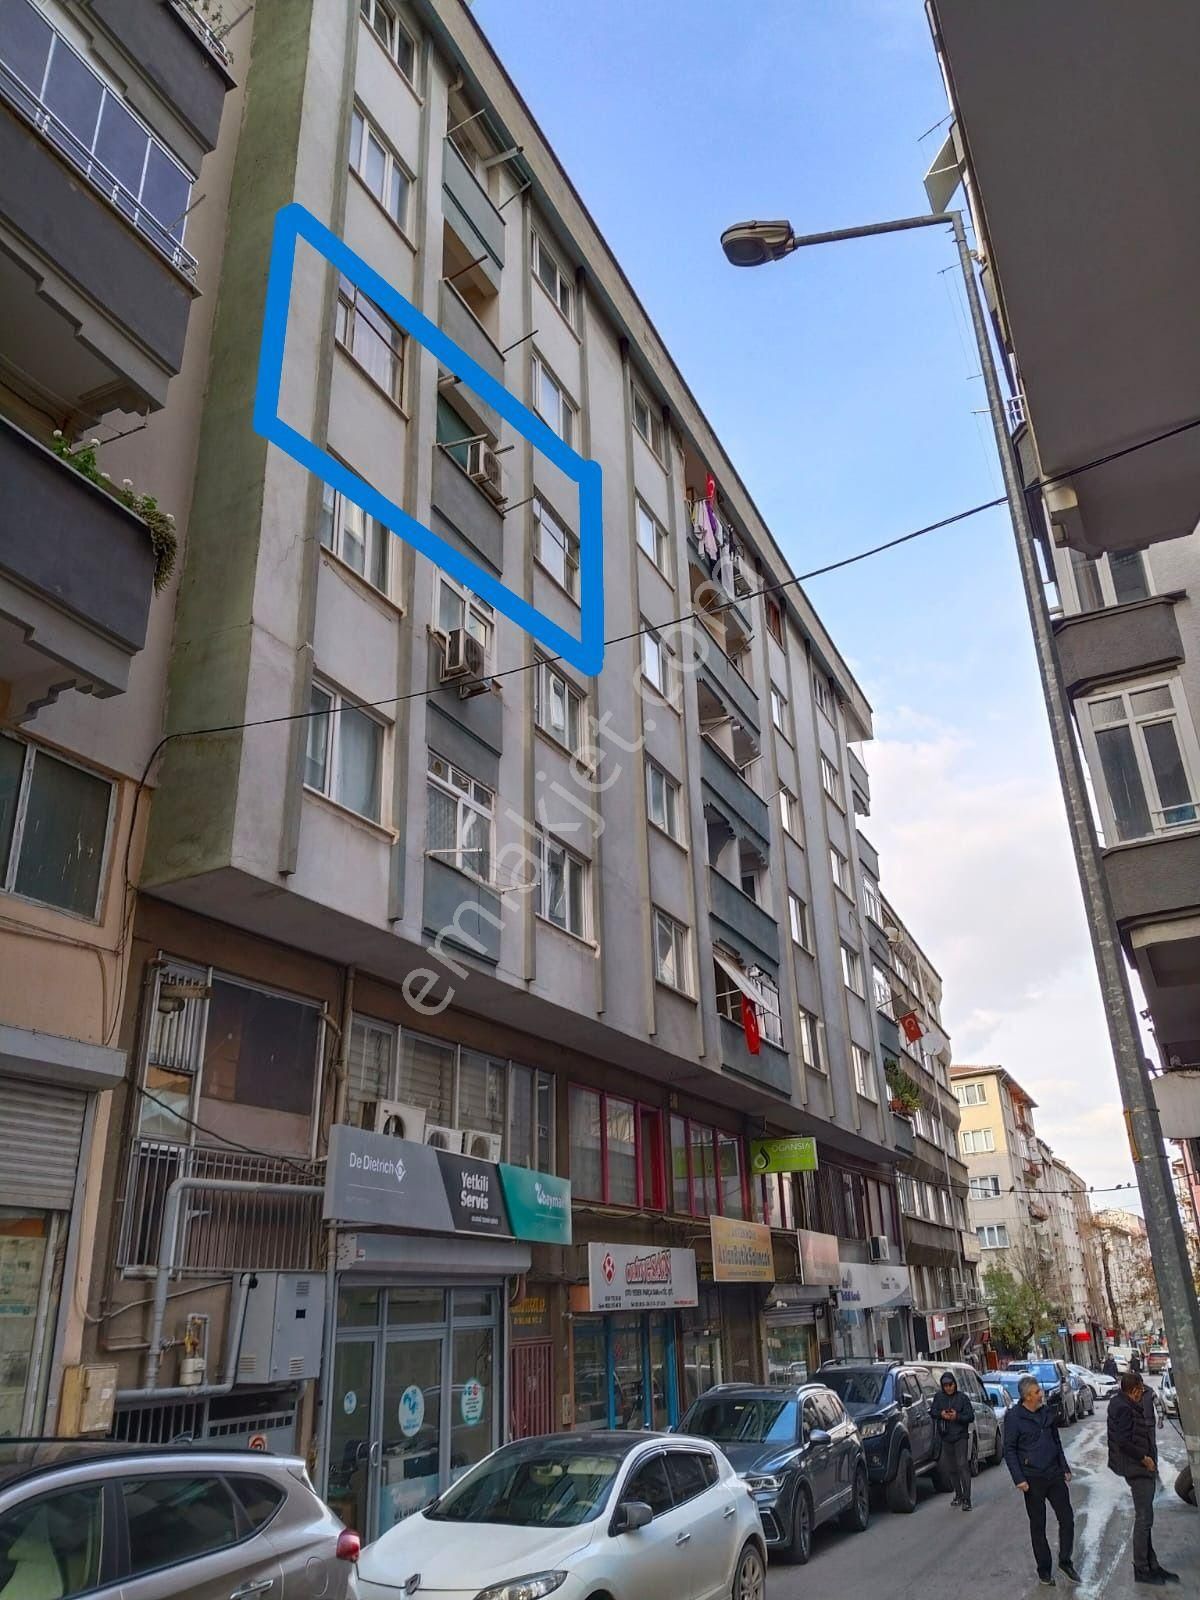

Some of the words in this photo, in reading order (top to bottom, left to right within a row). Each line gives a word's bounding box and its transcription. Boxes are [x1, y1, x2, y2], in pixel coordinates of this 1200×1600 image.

[349, 1152, 362, 1169] De
[363, 1155, 395, 1175] Dietrich
[460, 1171, 489, 1192] Yetkili
[460, 1190, 489, 1210] Servis
